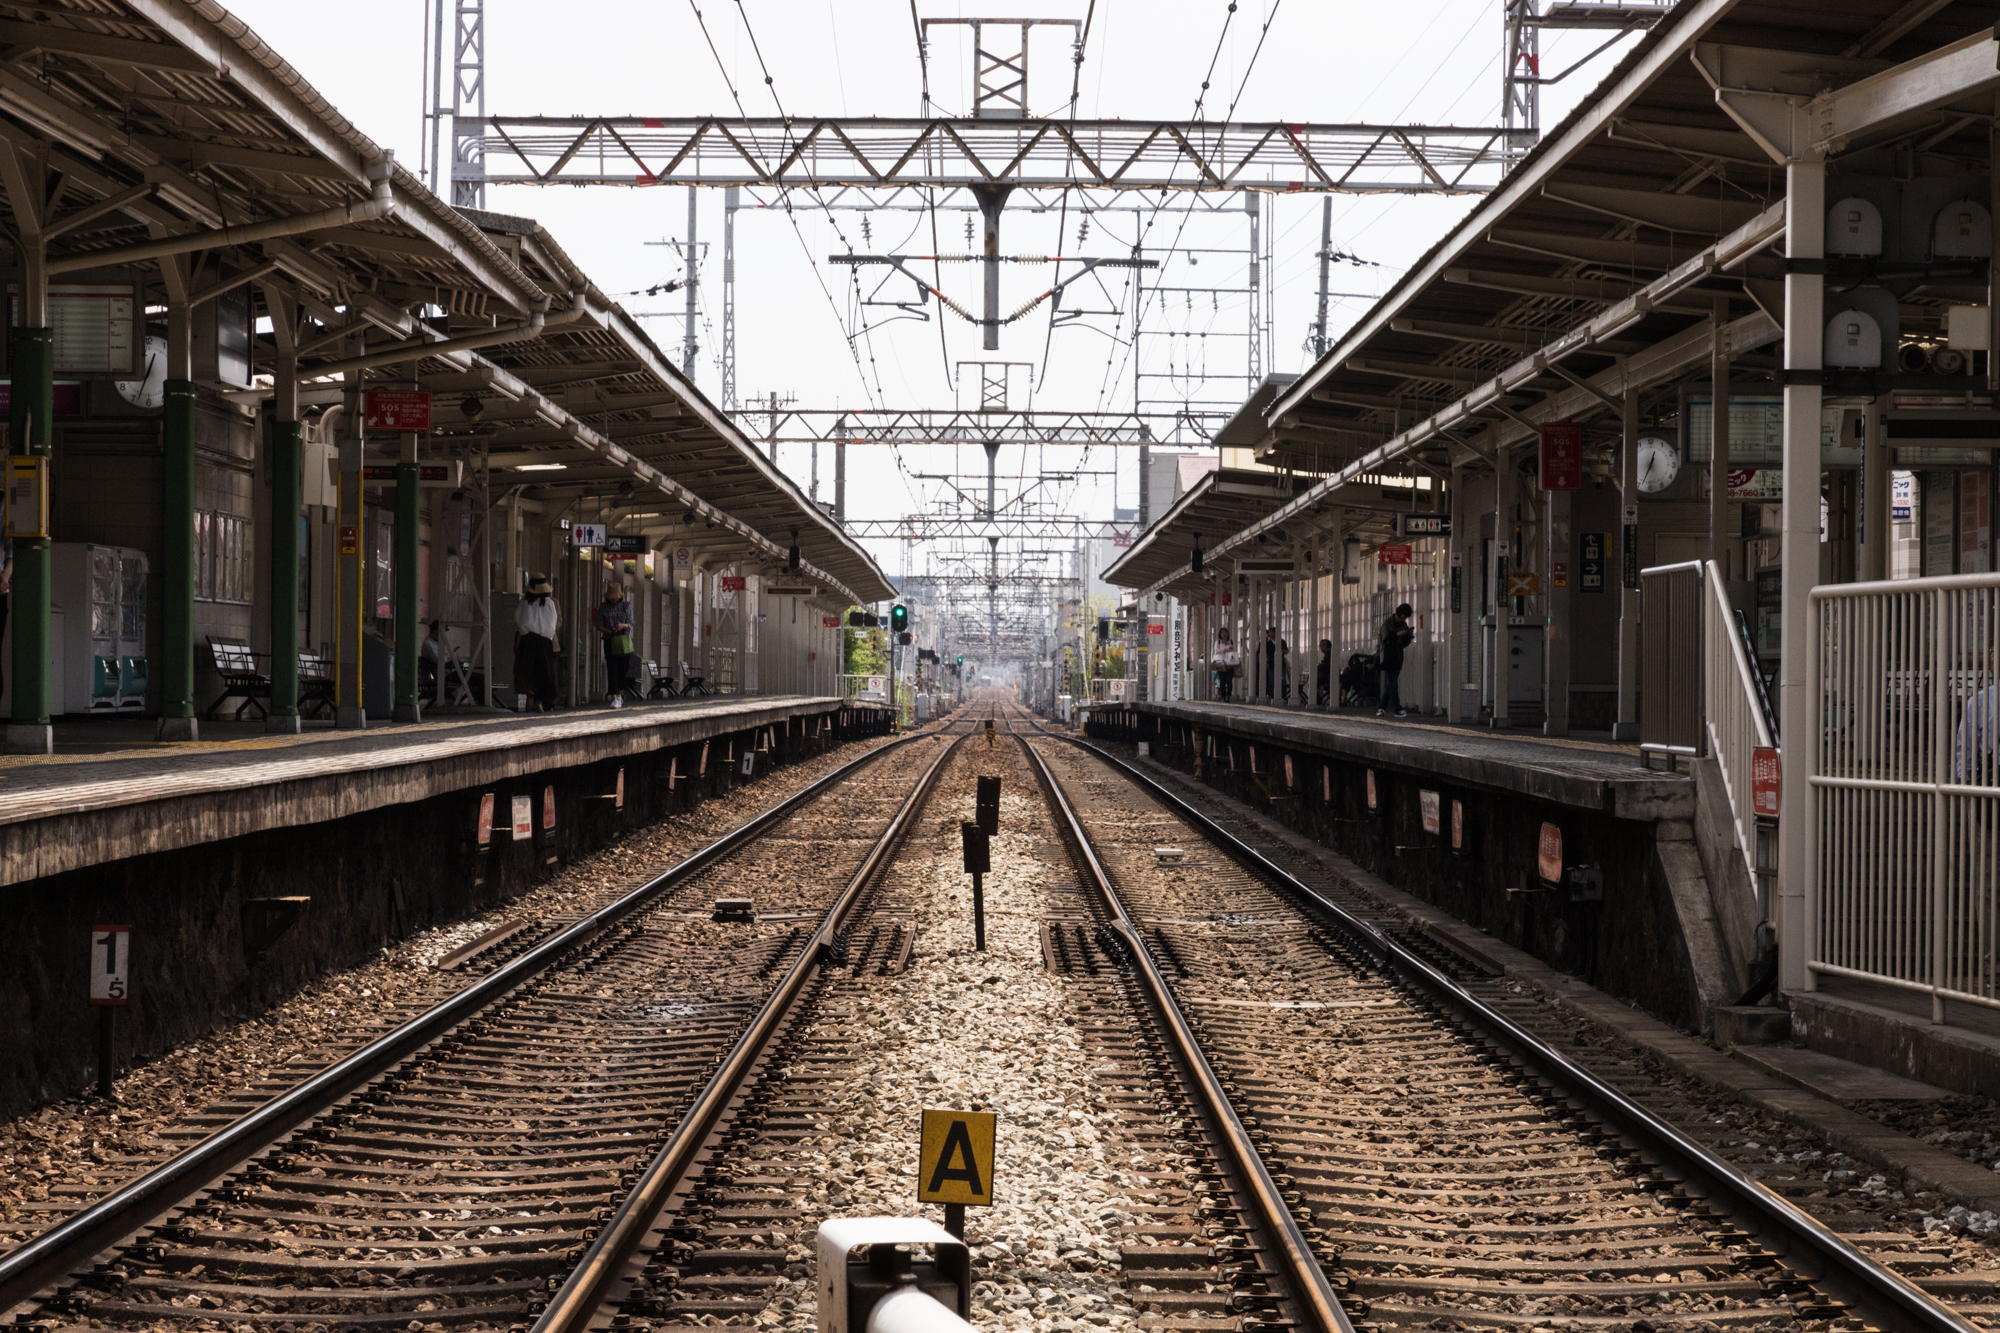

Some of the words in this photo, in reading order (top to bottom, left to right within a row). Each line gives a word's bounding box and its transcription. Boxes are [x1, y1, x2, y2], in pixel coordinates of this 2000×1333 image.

[119, 383, 126, 391] 8
[381, 404, 399, 412] SOS
[1892, 481, 1910, 489] ニック
[987, 730, 995, 739] S
[744, 757, 751, 771] 1
[97, 932, 116, 974] 1
[928, 1121, 984, 1195] A
